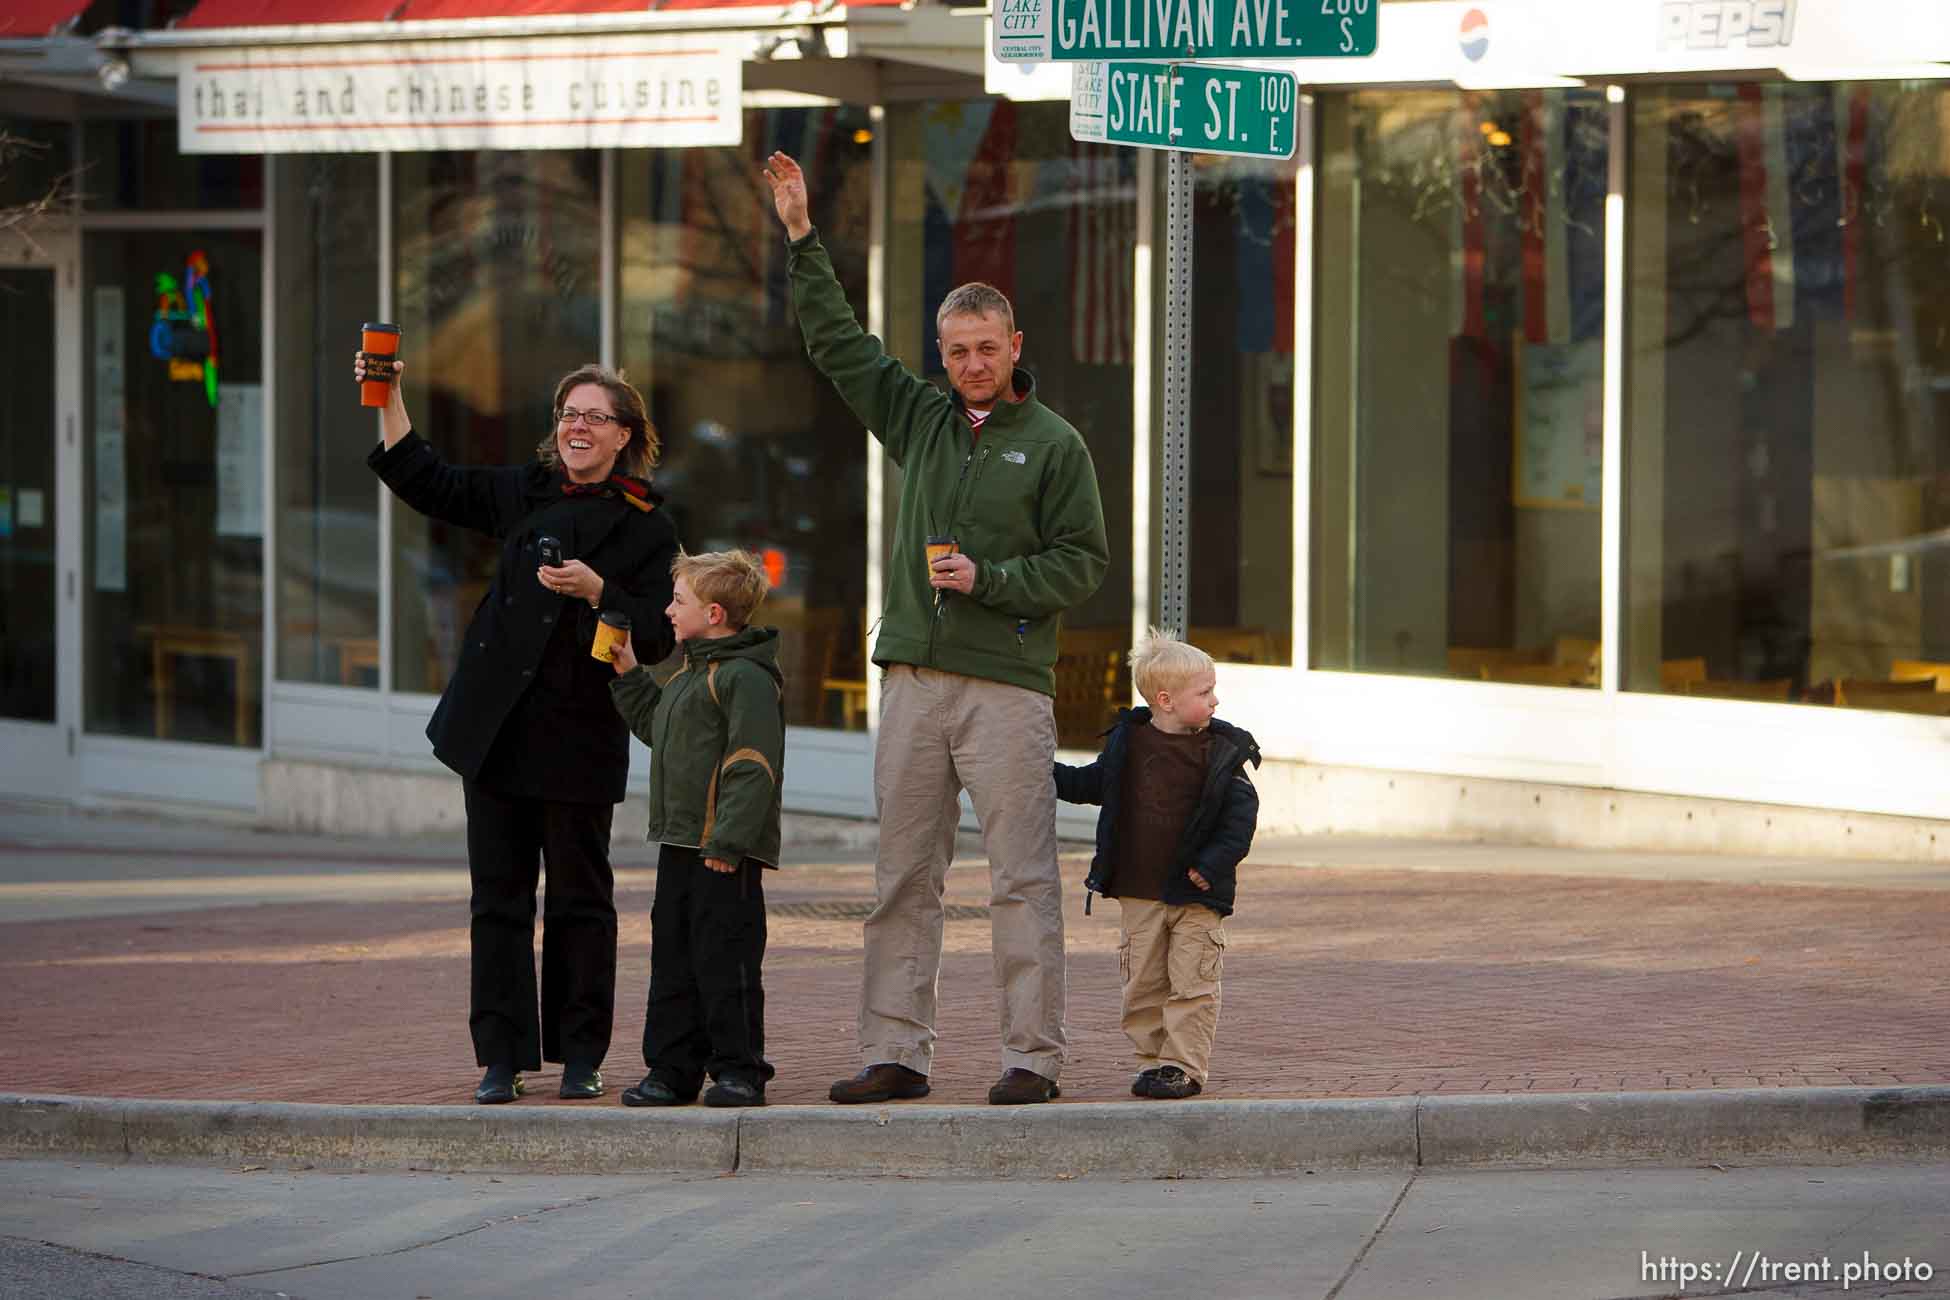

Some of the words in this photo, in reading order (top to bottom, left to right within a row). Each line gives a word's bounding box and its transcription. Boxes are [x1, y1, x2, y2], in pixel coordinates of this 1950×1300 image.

[1002, 0, 1041, 12] LAKE
[1003, 14, 1040, 30] CITY
[1058, 0, 1214, 49] GALLIVAN
[1231, 0, 1302, 47] AVE.
[1661, 0, 1796, 48] PEPSI
[1339, 17, 1359, 52] S.
[194, 78, 264, 117] thai
[296, 75, 356, 116] and
[386, 74, 534, 114] chinese
[569, 77, 720, 111] cuisine
[1110, 69, 1184, 137] STATE
[1204, 78, 1248, 142] ST.
[1259, 76, 1290, 113] 100
[1269, 116, 1283, 153] E.
